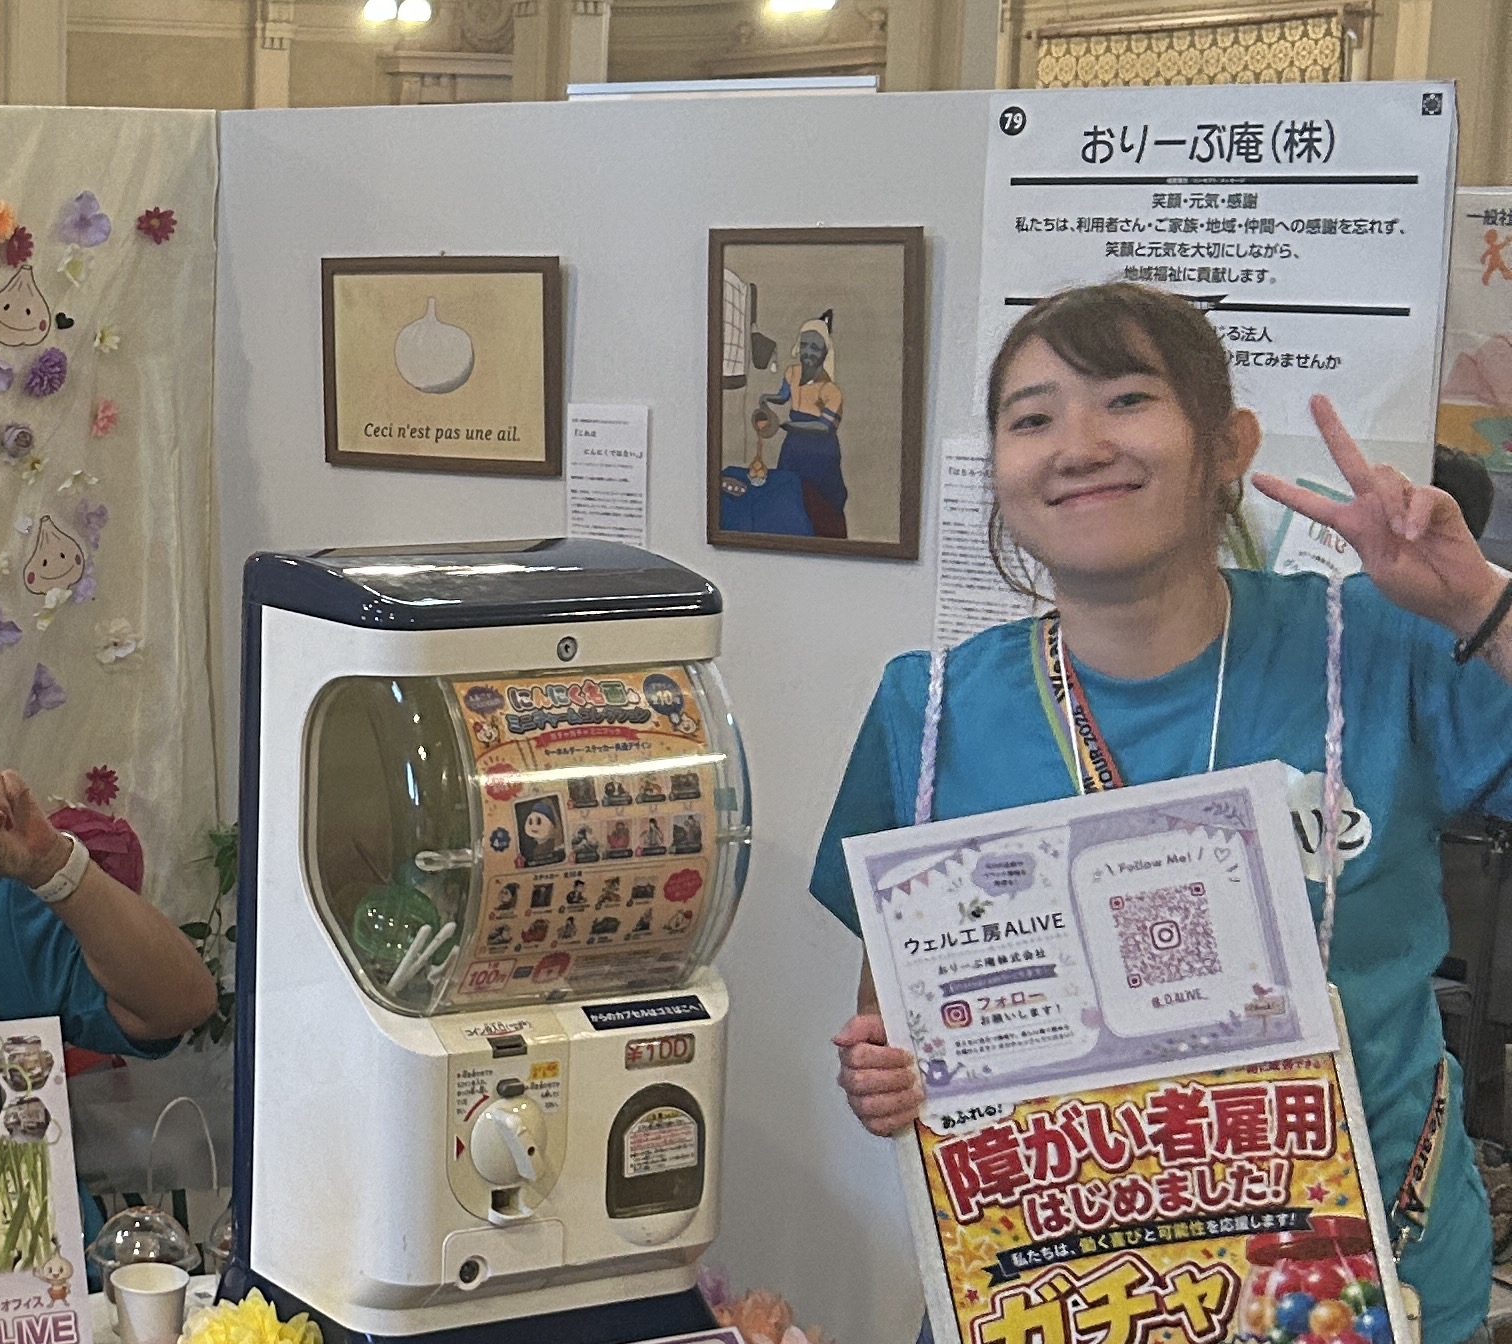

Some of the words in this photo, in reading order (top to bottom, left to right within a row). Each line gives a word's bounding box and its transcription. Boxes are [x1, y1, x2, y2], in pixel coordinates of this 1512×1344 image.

[1002, 110, 1024, 131] 79
[1151, 192, 1258, 210] 笑顔・元気・感謝
[1104, 240, 1299, 260] 笑顔と元気を大切にしながら、
[364, 422, 393, 441] Ceci
[396, 423, 430, 441] n'est
[434, 427, 461, 444] pas
[465, 427, 493, 443] une
[496, 424, 522, 443] ail.
[939, 1081, 1335, 1216] 障がい者雇用
